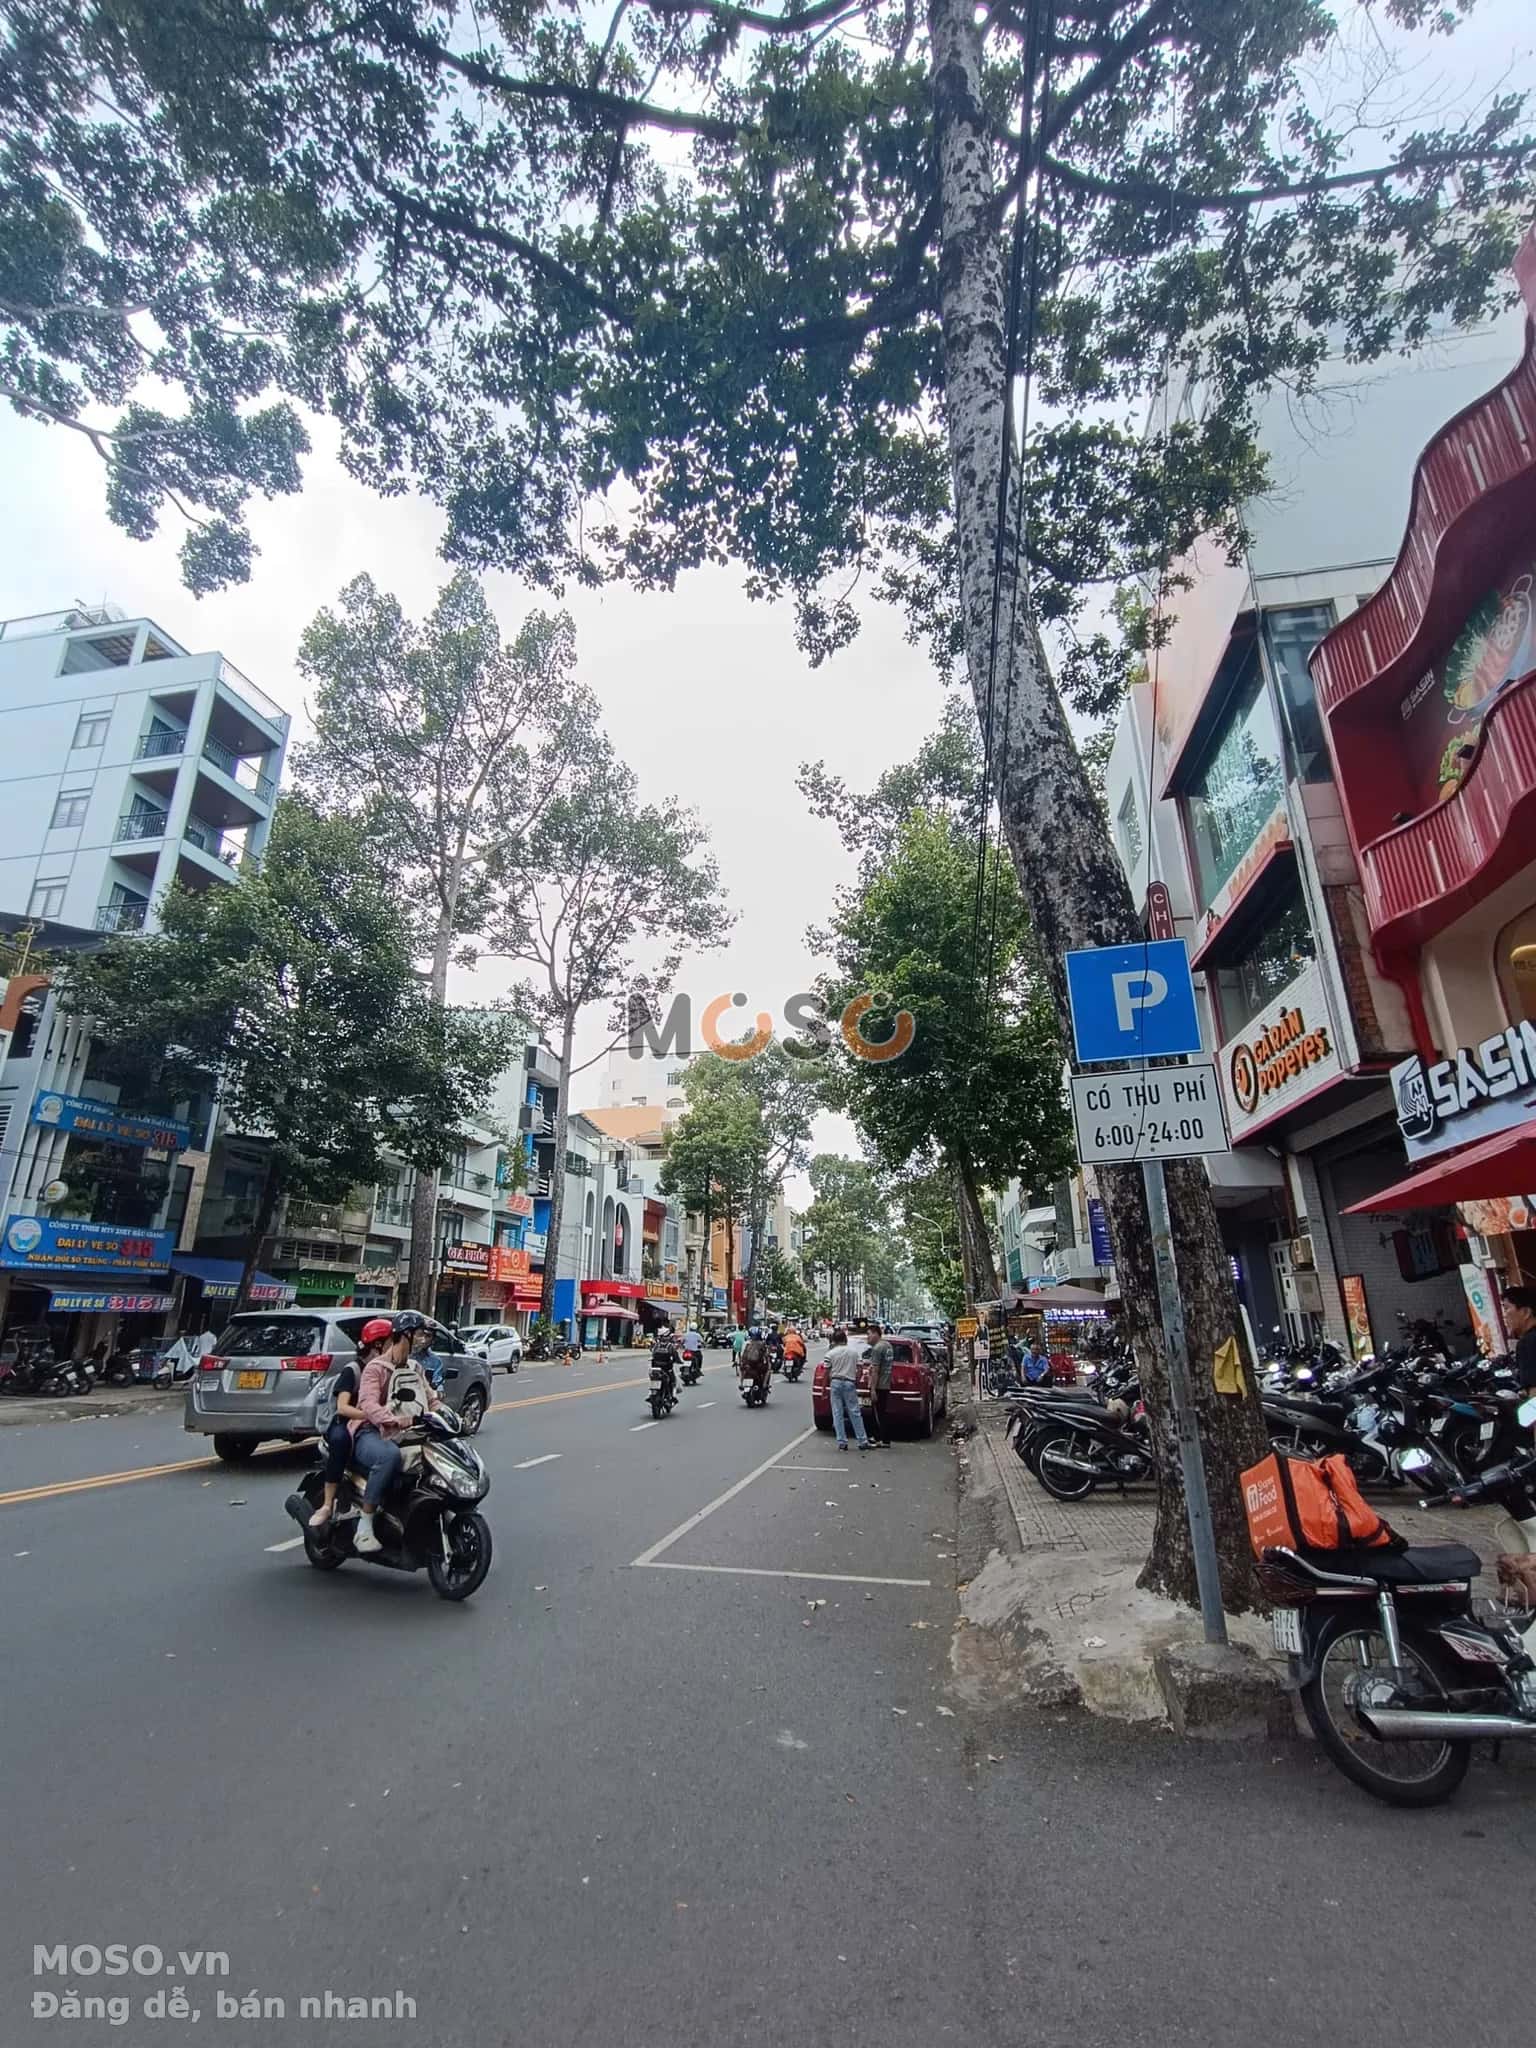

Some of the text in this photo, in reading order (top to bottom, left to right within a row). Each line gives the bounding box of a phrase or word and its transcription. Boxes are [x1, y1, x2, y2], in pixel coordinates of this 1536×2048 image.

[1112, 970, 1168, 1031] P
[1269, 1006, 1305, 1053] RÁN
[1086, 1074, 1207, 1111] CÓ THU PHÍ
